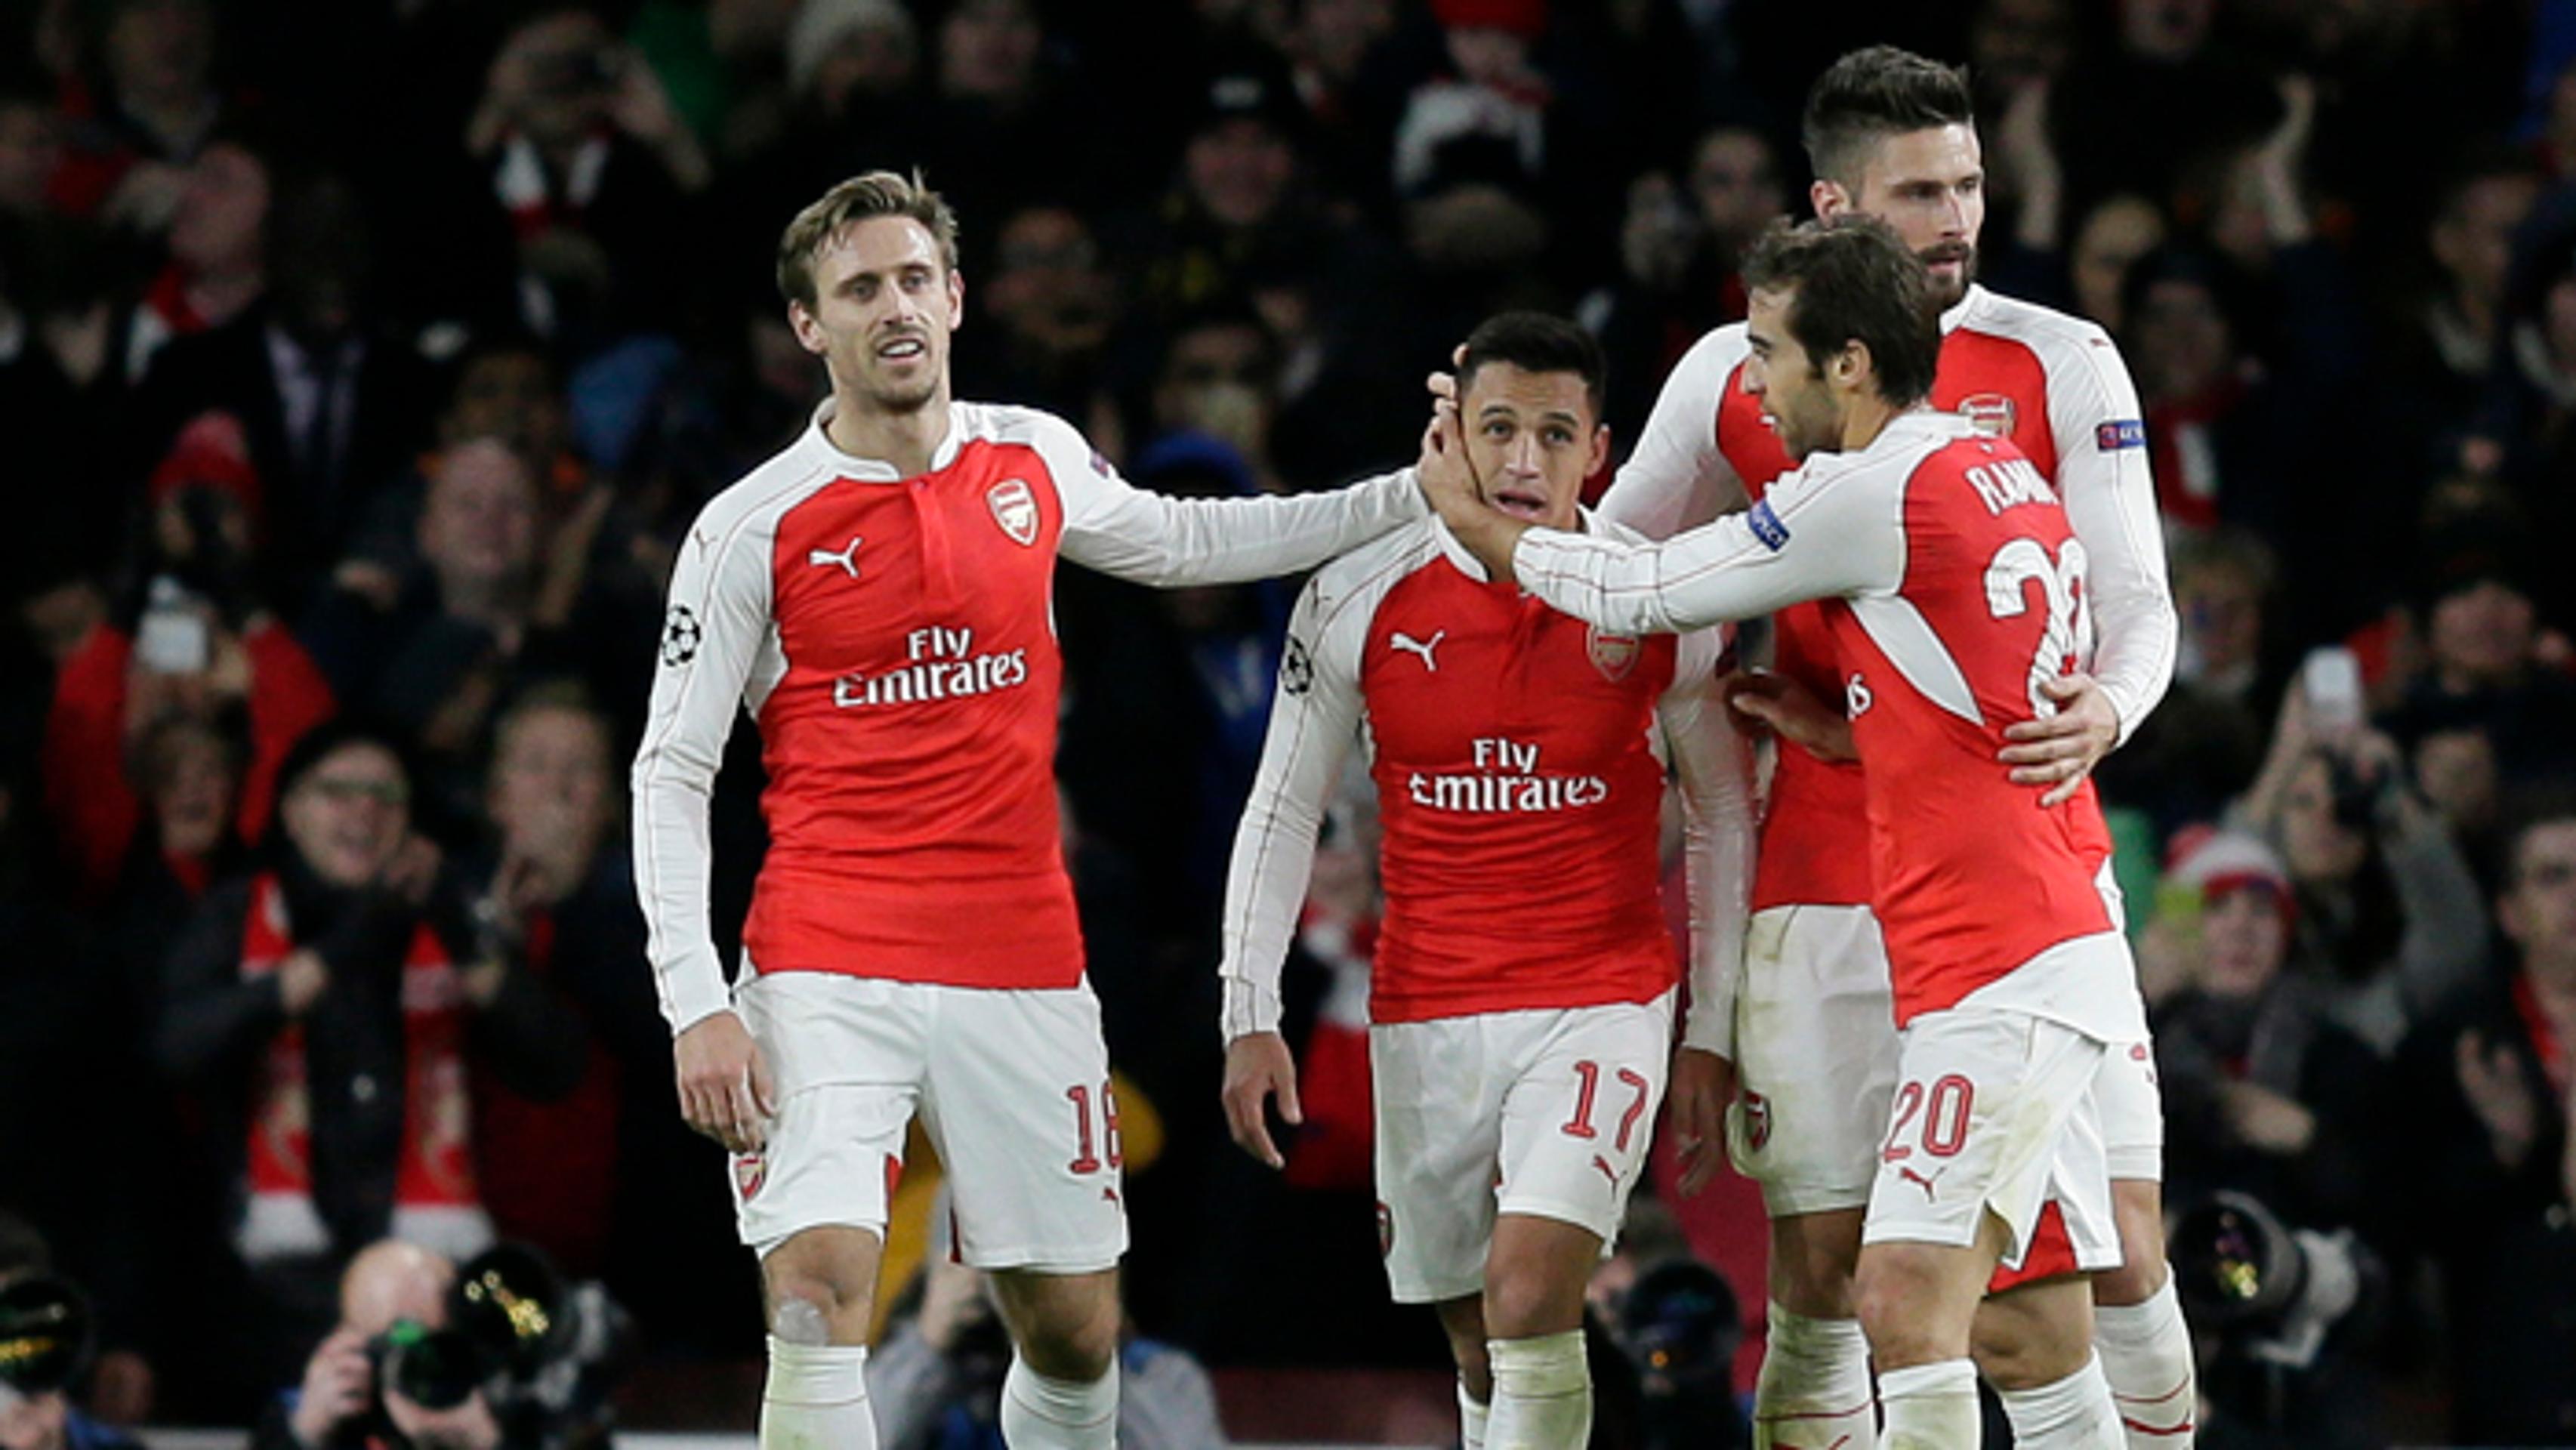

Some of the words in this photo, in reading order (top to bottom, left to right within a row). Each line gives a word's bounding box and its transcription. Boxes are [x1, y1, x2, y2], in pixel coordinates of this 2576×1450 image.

[908, 625, 971, 660] Fly
[834, 648, 1027, 708] Emirates
[1473, 738, 1538, 774] Fly
[1408, 770, 1607, 812] Emirates
[1561, 1060, 1647, 1154] 17
[1882, 1074, 1973, 1162] 20
